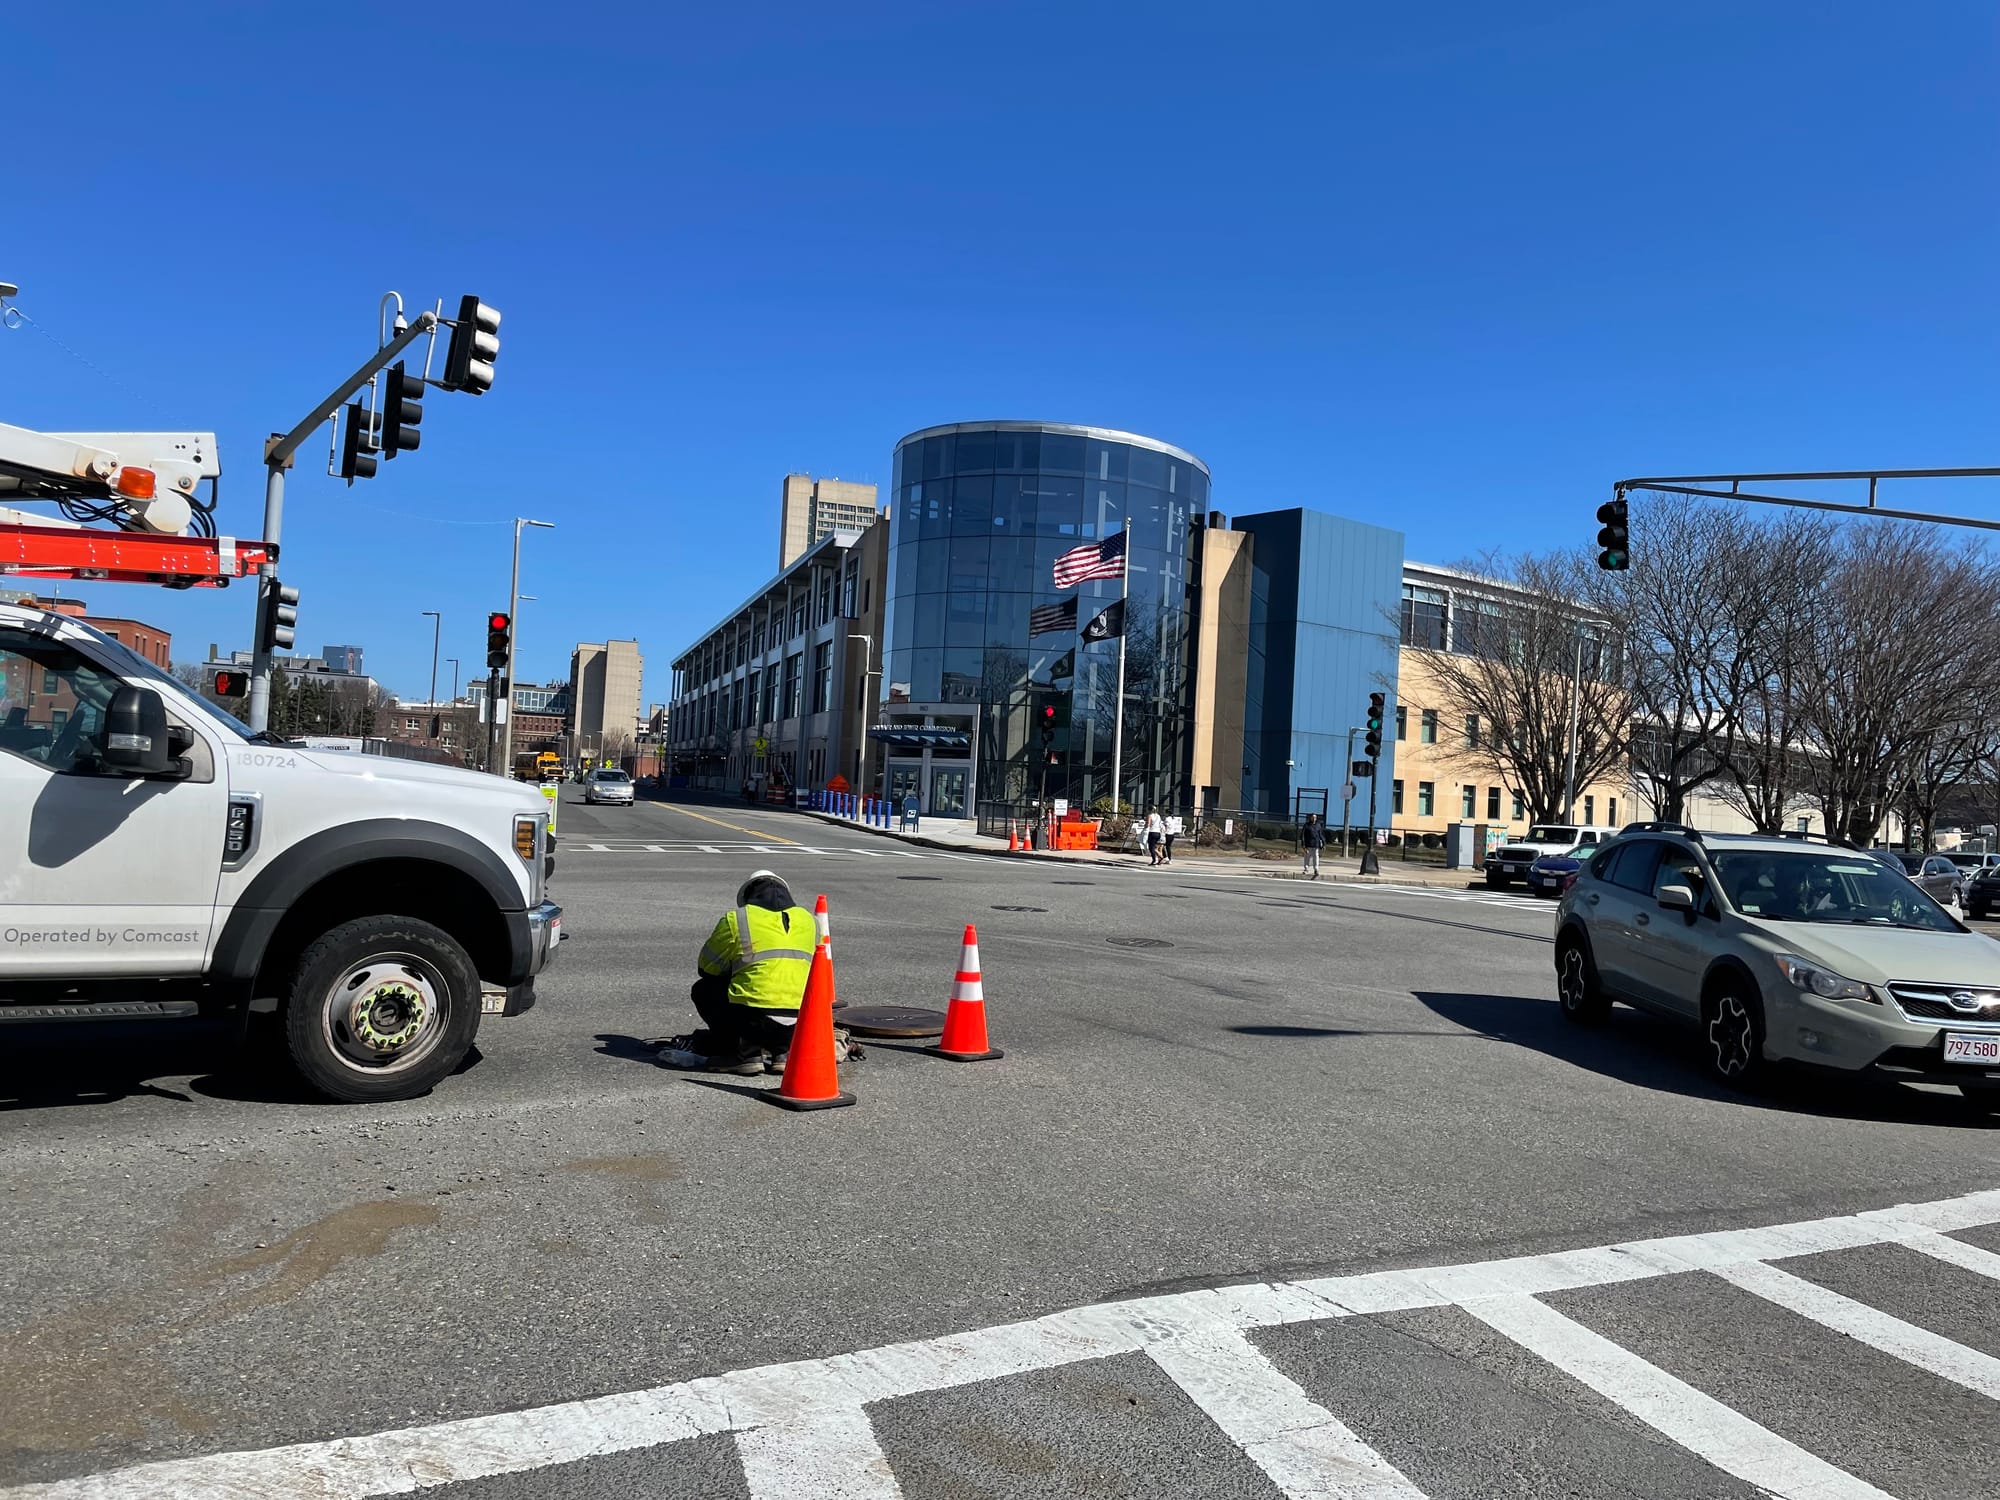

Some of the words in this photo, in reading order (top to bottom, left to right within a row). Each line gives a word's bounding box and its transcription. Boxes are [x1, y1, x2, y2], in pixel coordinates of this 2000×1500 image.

[237, 753, 296, 769] 180724
[4, 928, 91, 946] Operated
[96, 928, 118, 946] by
[122, 928, 200, 943] Comcast
[1947, 1040, 1972, 1056] 79Z
[1973, 1041, 1998, 1057] 580
